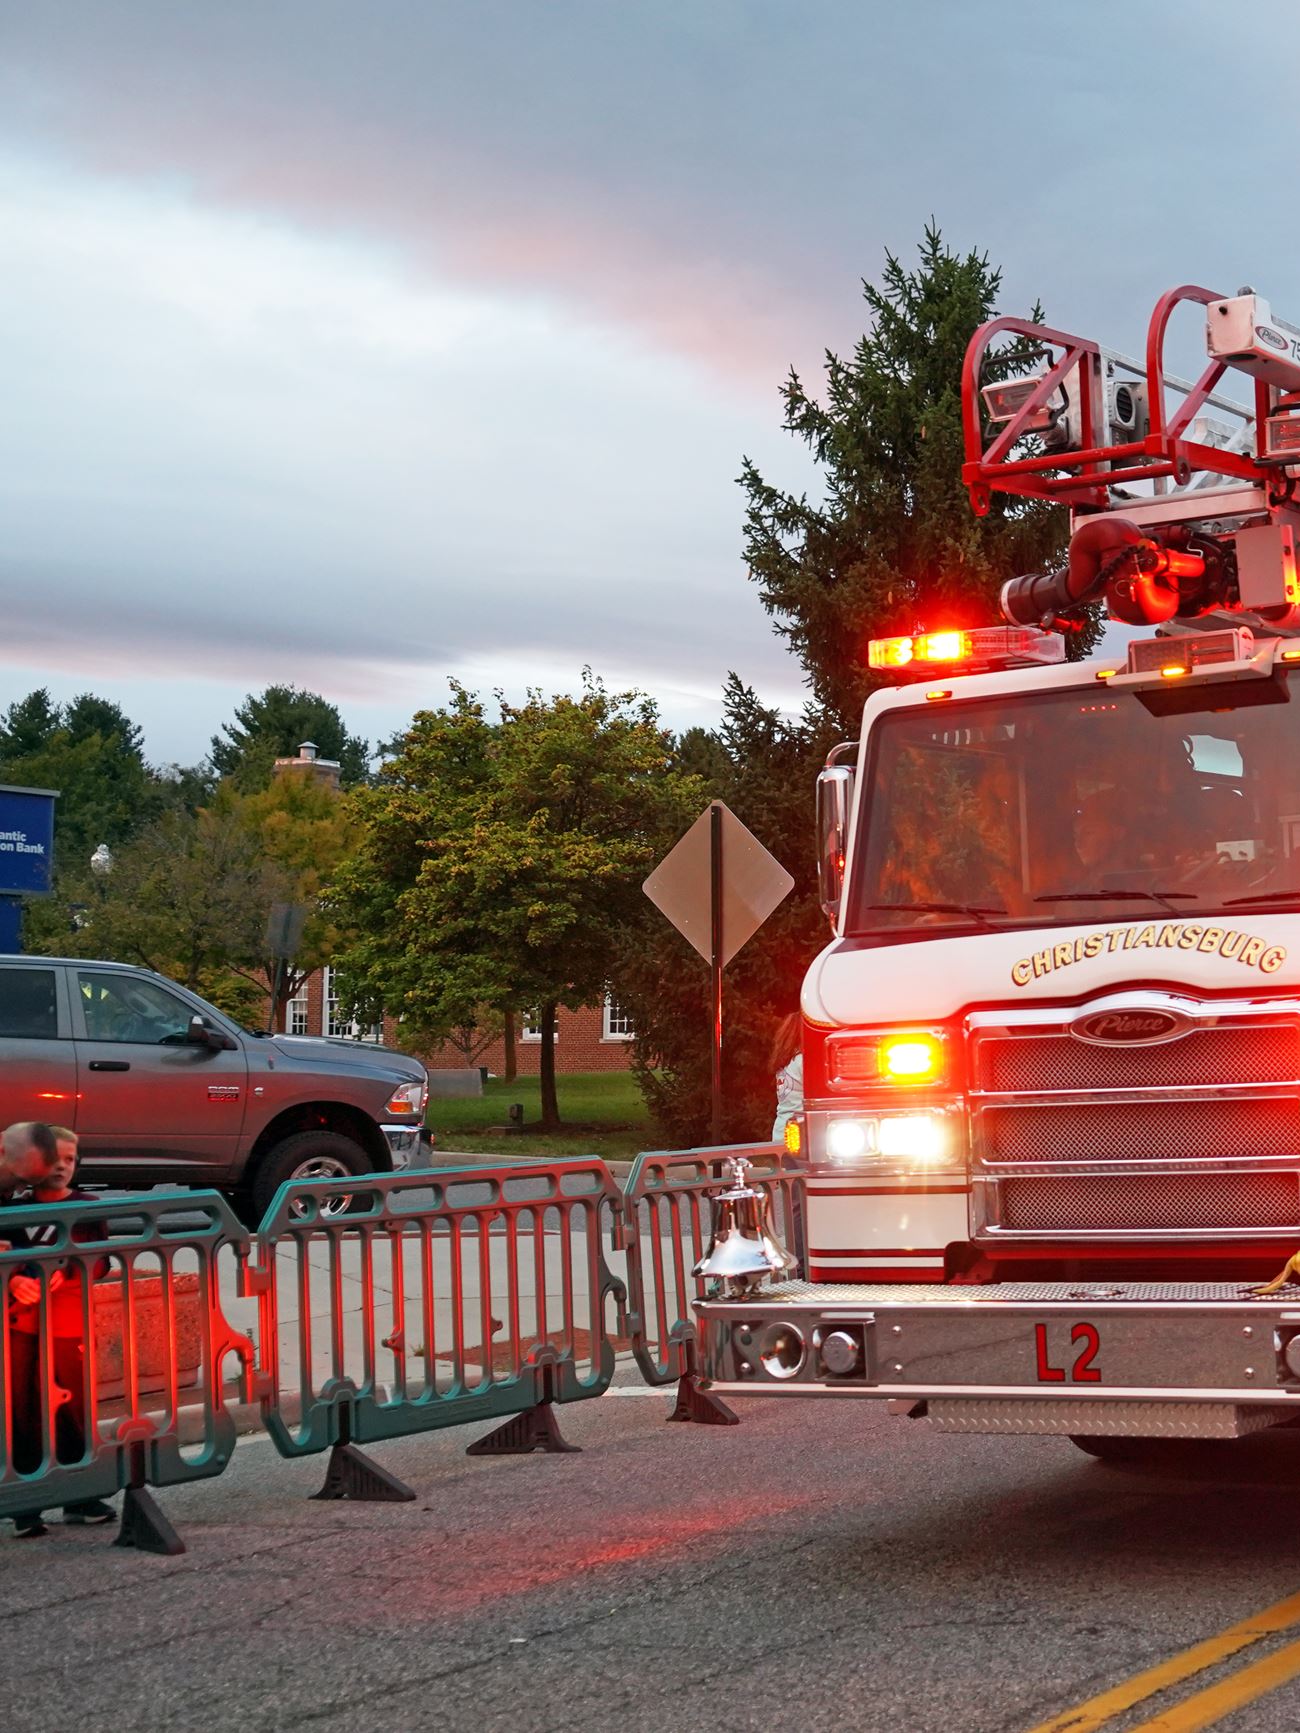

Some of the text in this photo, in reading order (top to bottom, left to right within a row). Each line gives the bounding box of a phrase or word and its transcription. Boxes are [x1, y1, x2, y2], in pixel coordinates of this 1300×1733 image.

[16, 842, 45, 855] Bank
[1011, 924, 1287, 987] CHRISTIANSBURG
[1094, 1013, 1166, 1036] Pierce
[1035, 1322, 1102, 1382] L2
